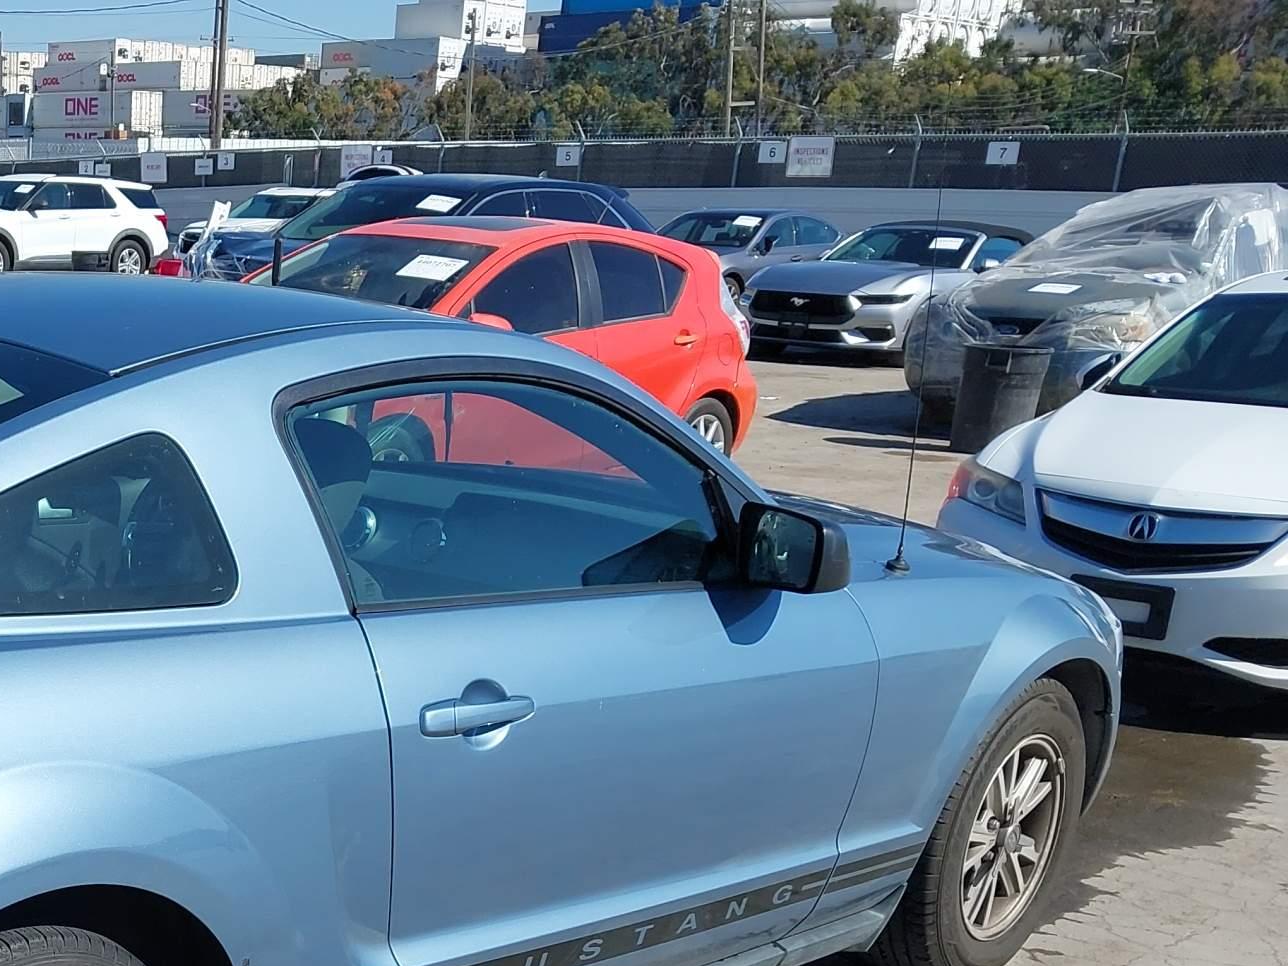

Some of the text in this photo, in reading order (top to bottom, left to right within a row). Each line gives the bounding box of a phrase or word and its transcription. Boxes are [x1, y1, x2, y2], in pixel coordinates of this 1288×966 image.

[57, 52, 76, 62] OOCL
[332, 53, 354, 62] OOCL
[117, 73, 137, 83] OOCL
[64, 97, 99, 116] ONE
[565, 151, 571, 161] 5
[769, 146, 777, 158] 6
[999, 147, 1008, 159] 7
[223, 157, 229, 166] 3
[84, 165, 89, 173] 2
